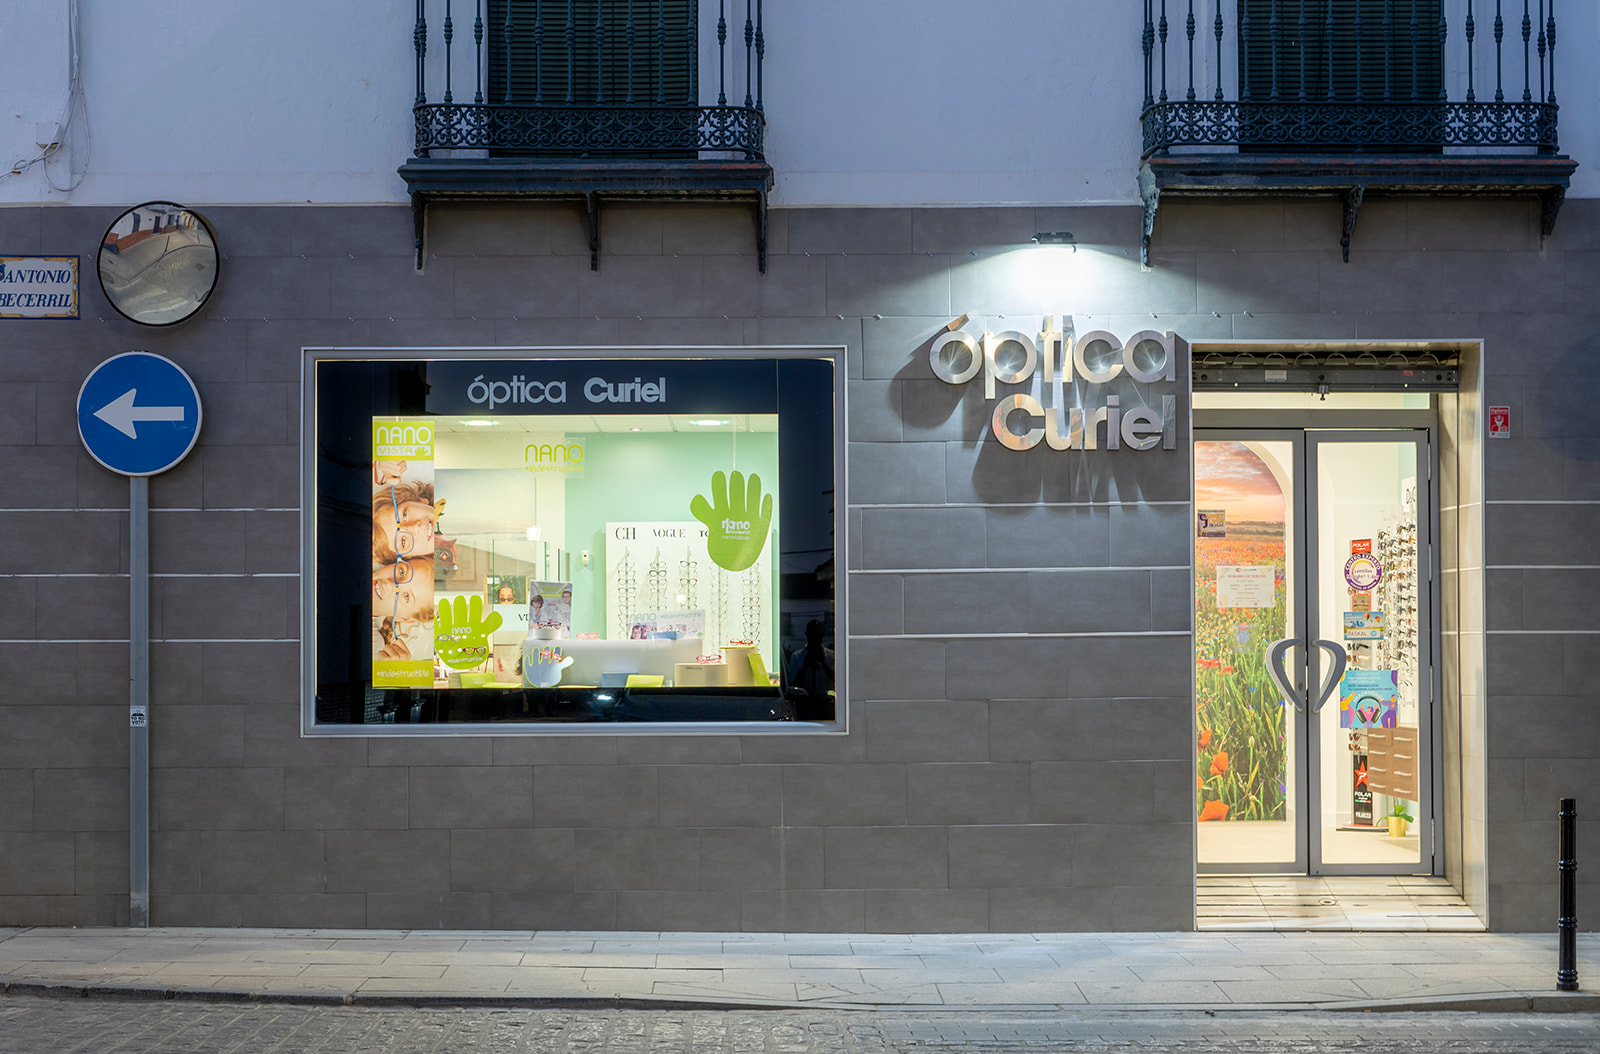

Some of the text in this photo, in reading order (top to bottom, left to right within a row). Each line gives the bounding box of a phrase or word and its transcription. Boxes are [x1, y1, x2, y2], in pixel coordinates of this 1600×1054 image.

[0, 293, 73, 308] BECERRIL
[929, 313, 1177, 400] óptica
[467, 374, 666, 410] óptica Curiel
[991, 393, 1177, 451] Curiel
[378, 446, 413, 455] VISTA
[615, 527, 637, 541] CH
[652, 528, 686, 538] VOGUE
